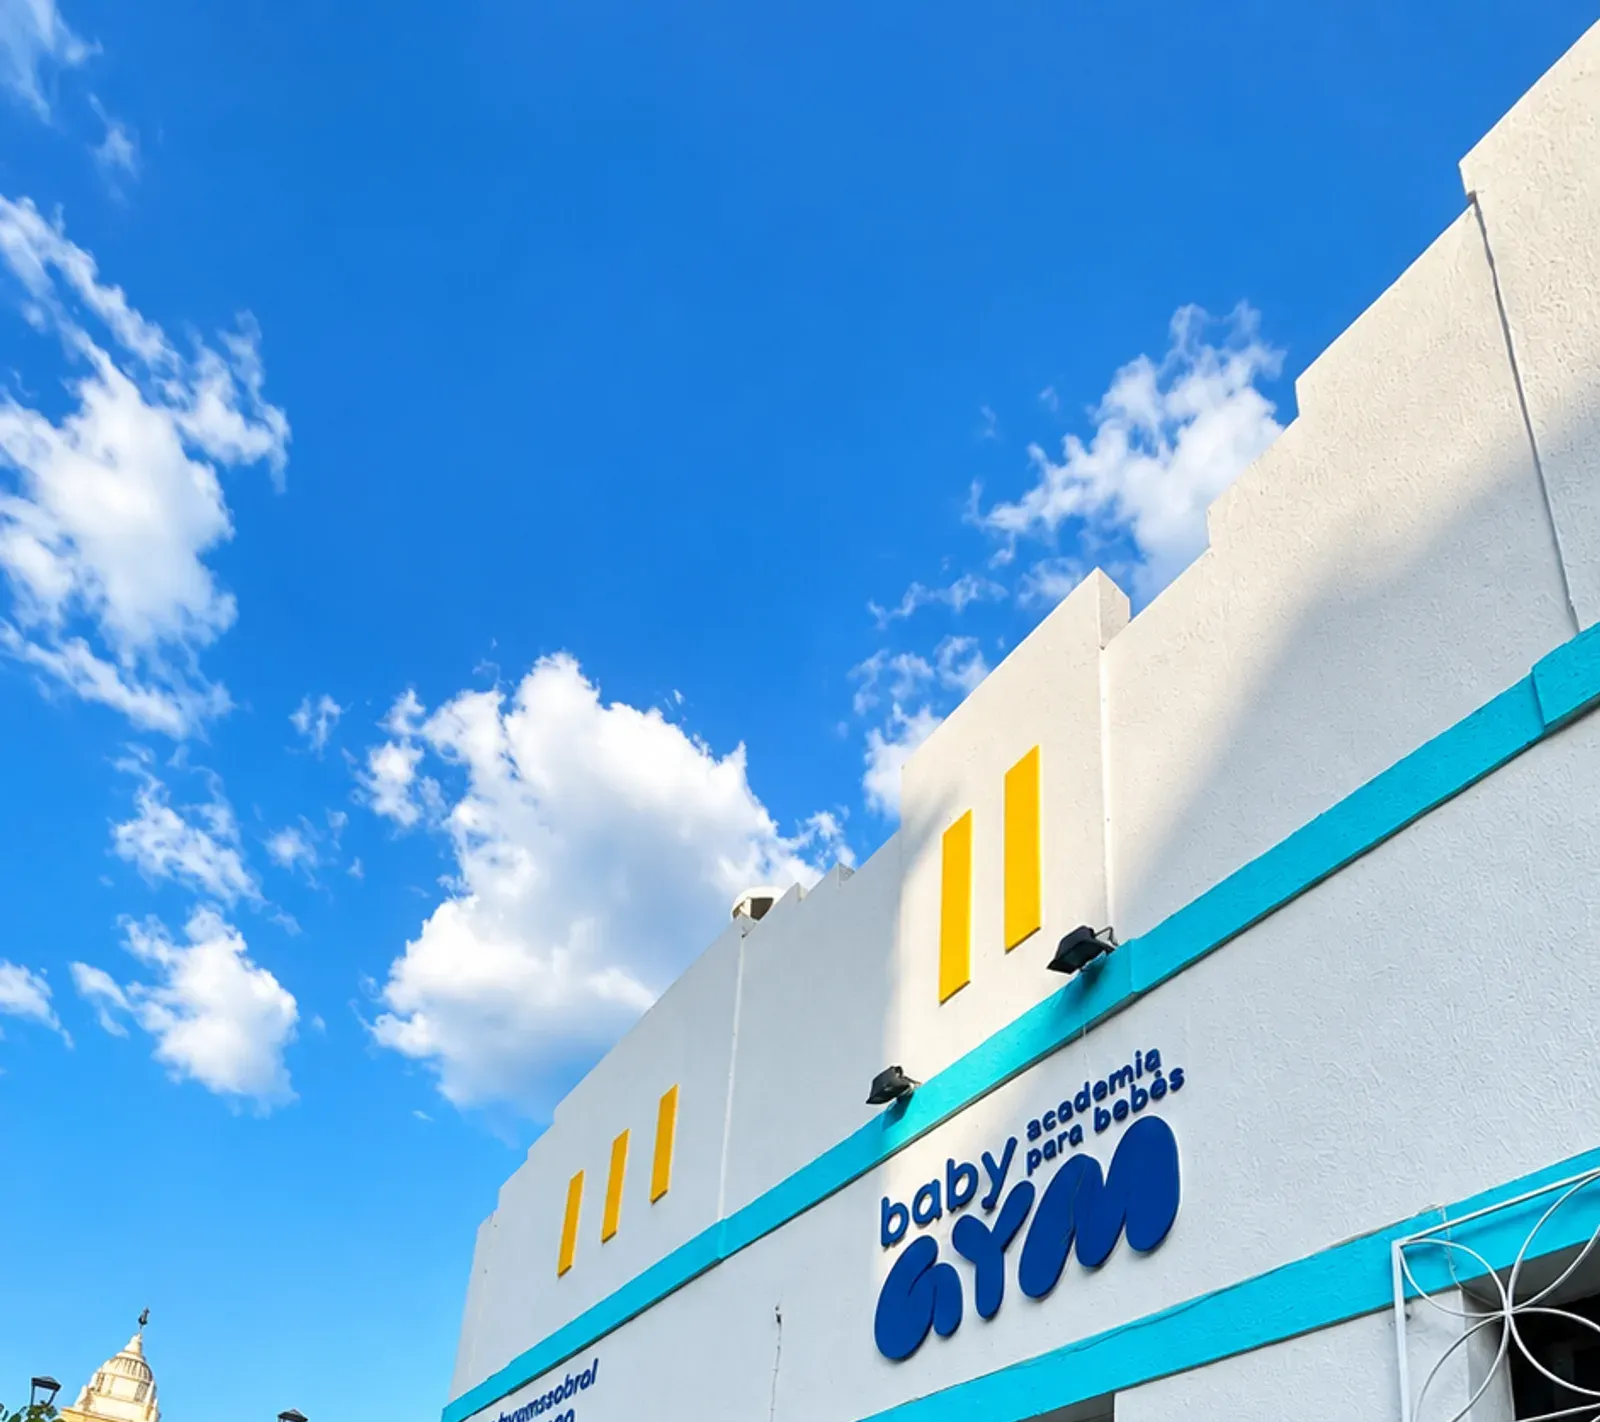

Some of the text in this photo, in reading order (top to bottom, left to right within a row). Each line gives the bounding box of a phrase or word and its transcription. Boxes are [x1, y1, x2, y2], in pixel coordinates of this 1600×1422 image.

[1026, 1048, 1162, 1142] academia
[881, 1136, 1019, 1249] baby
[1026, 1123, 1084, 1177] para
[874, 1115, 1180, 1361] GYM
